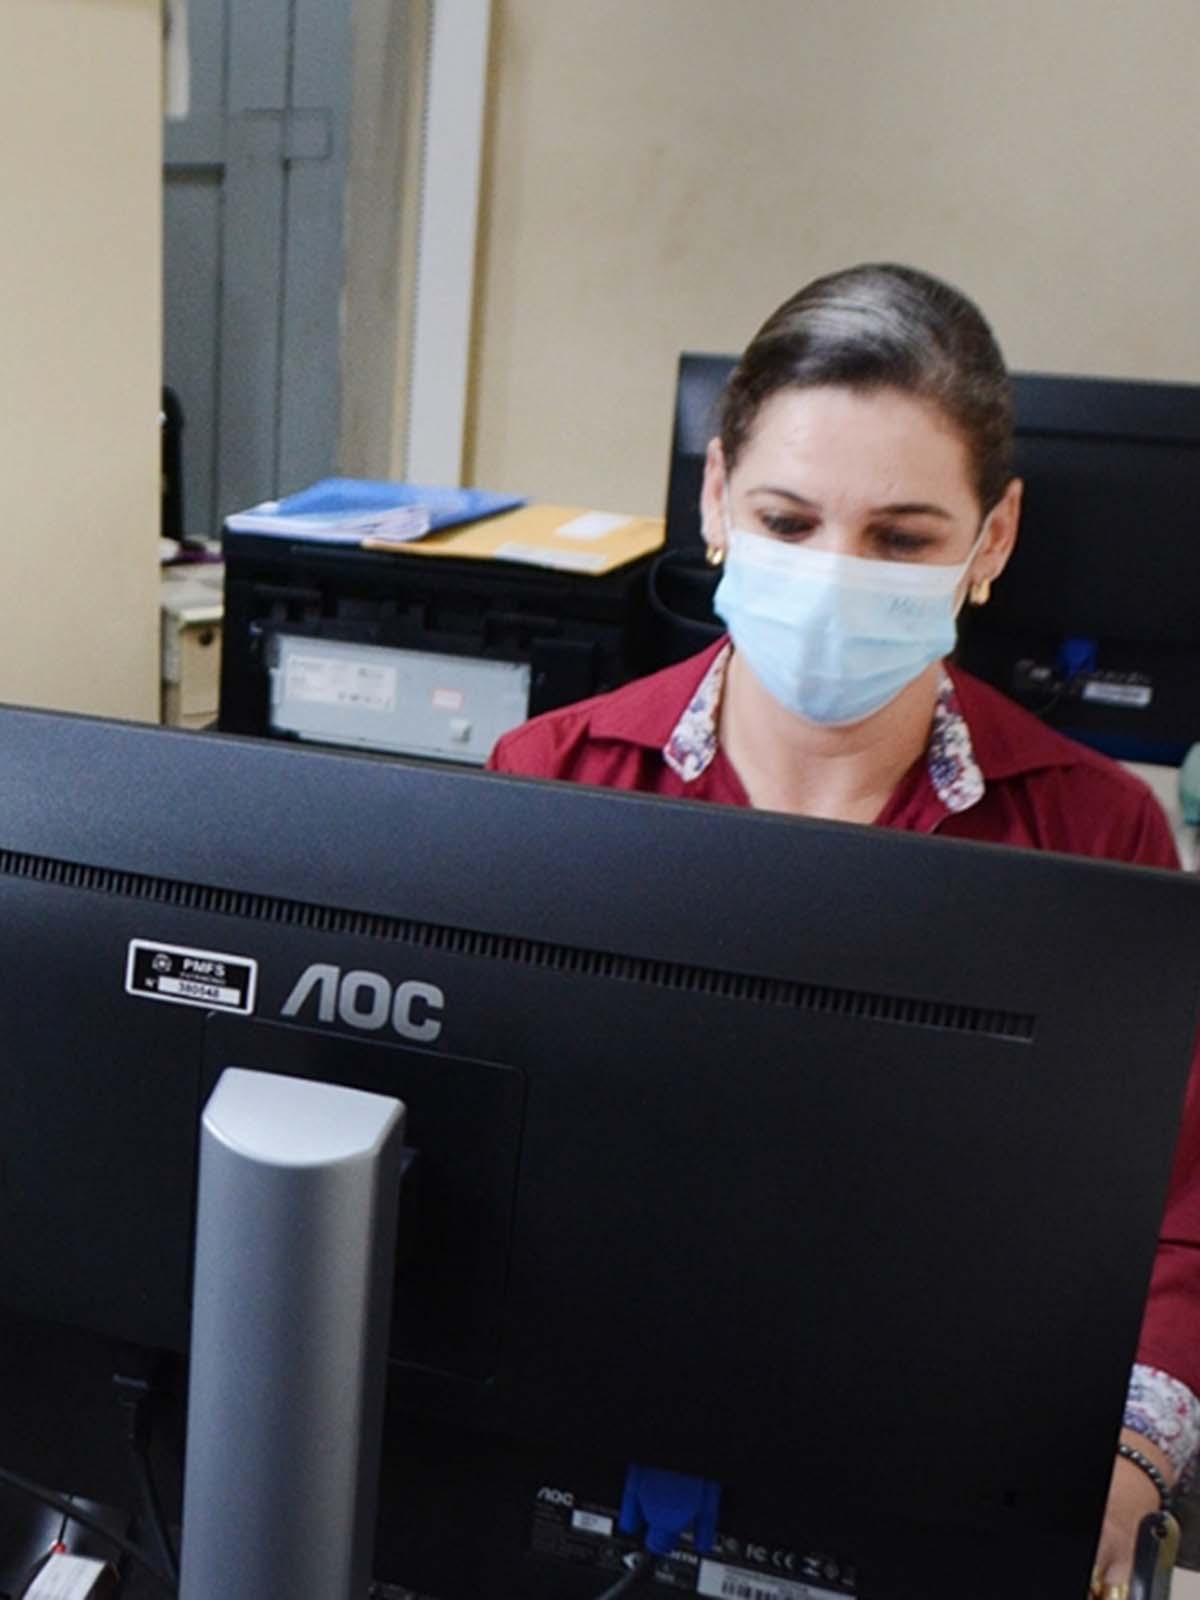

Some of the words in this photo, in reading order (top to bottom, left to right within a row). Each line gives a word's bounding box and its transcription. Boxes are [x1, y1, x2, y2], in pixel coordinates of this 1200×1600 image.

[182, 958, 225, 977] PMFS
[280, 963, 445, 1042] AOC
[536, 1486, 575, 1507] AOC
